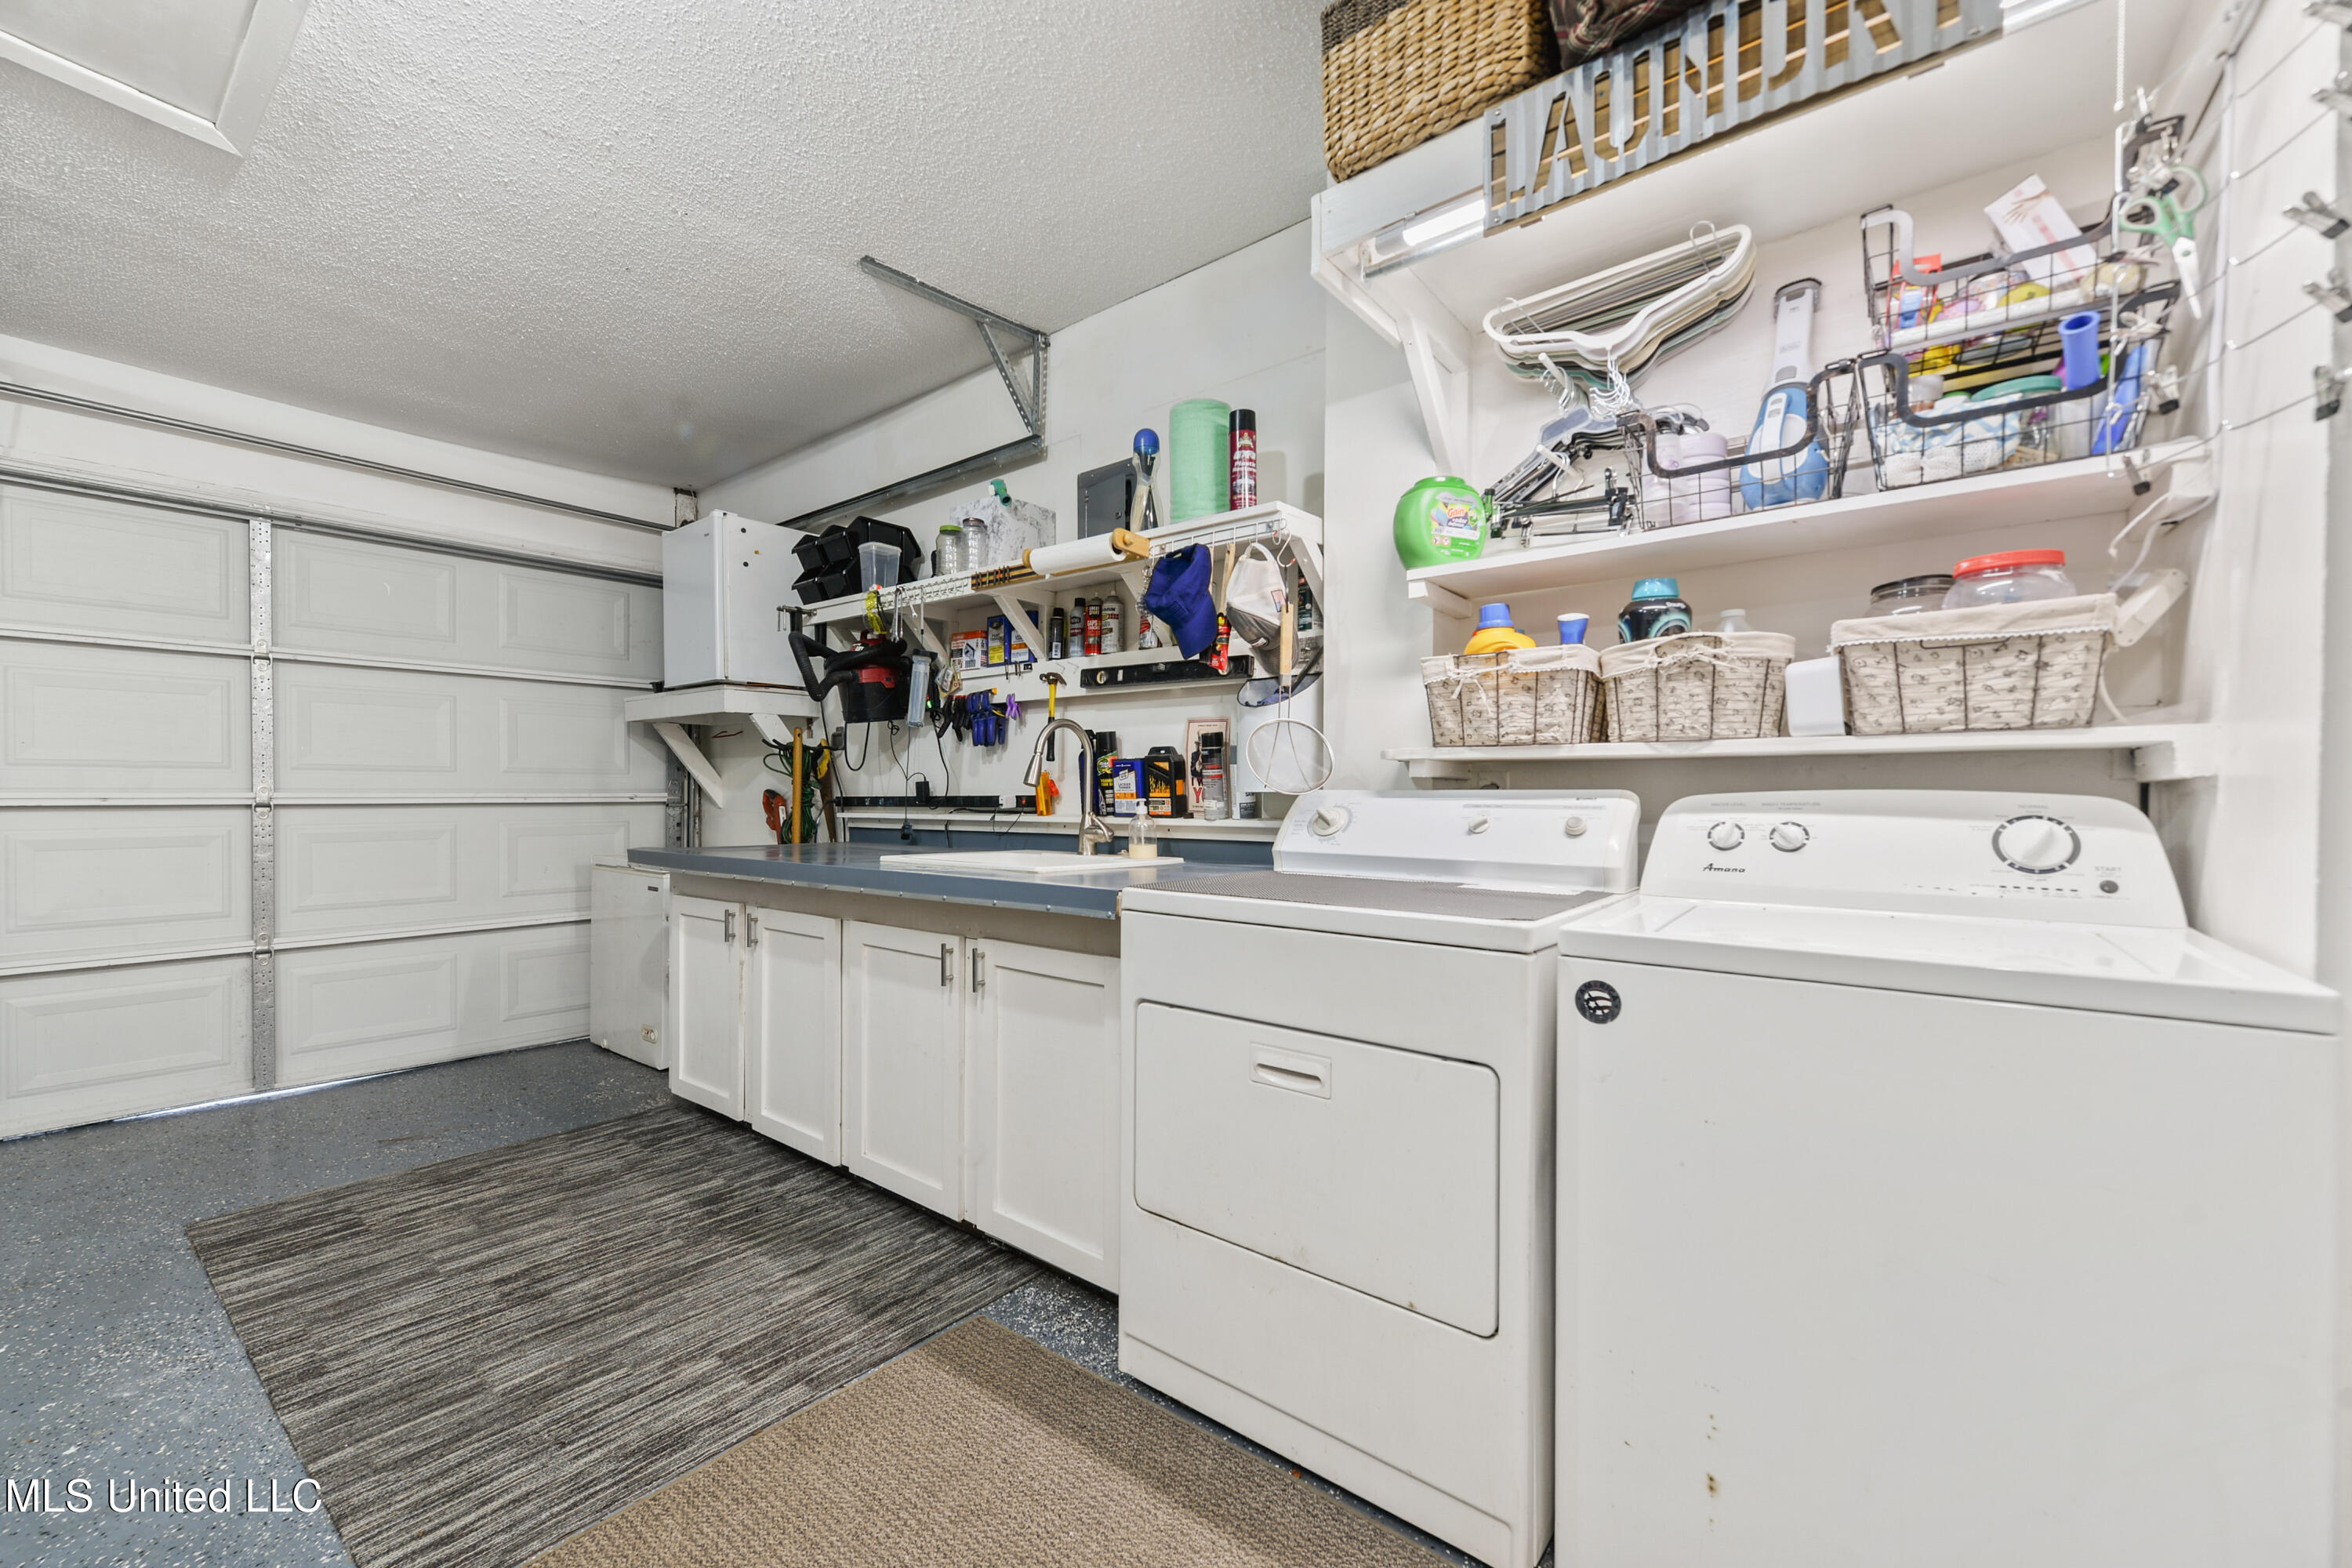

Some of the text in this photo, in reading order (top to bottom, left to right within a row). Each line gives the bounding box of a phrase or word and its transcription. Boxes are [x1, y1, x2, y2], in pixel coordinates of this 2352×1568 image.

[1490, 0, 1962, 211] LAUNDR
[1448, 508, 1465, 517] Gain
[1702, 862, 1746, 873] Amana
